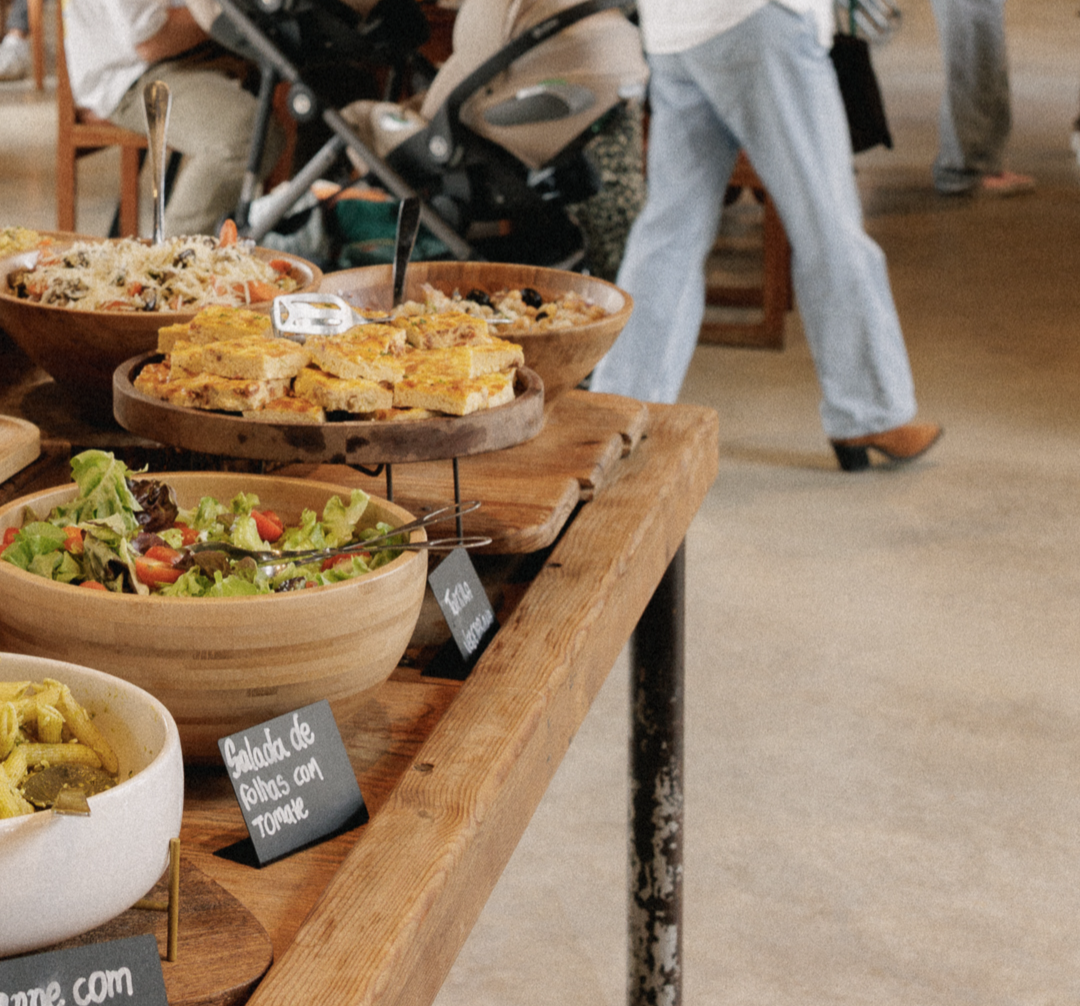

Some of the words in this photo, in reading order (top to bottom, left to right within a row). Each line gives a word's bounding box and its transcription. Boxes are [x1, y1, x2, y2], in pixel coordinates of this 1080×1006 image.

[224, 728, 291, 779] Salada
[290, 712, 315, 752] de
[73, 966, 133, 1006] com
